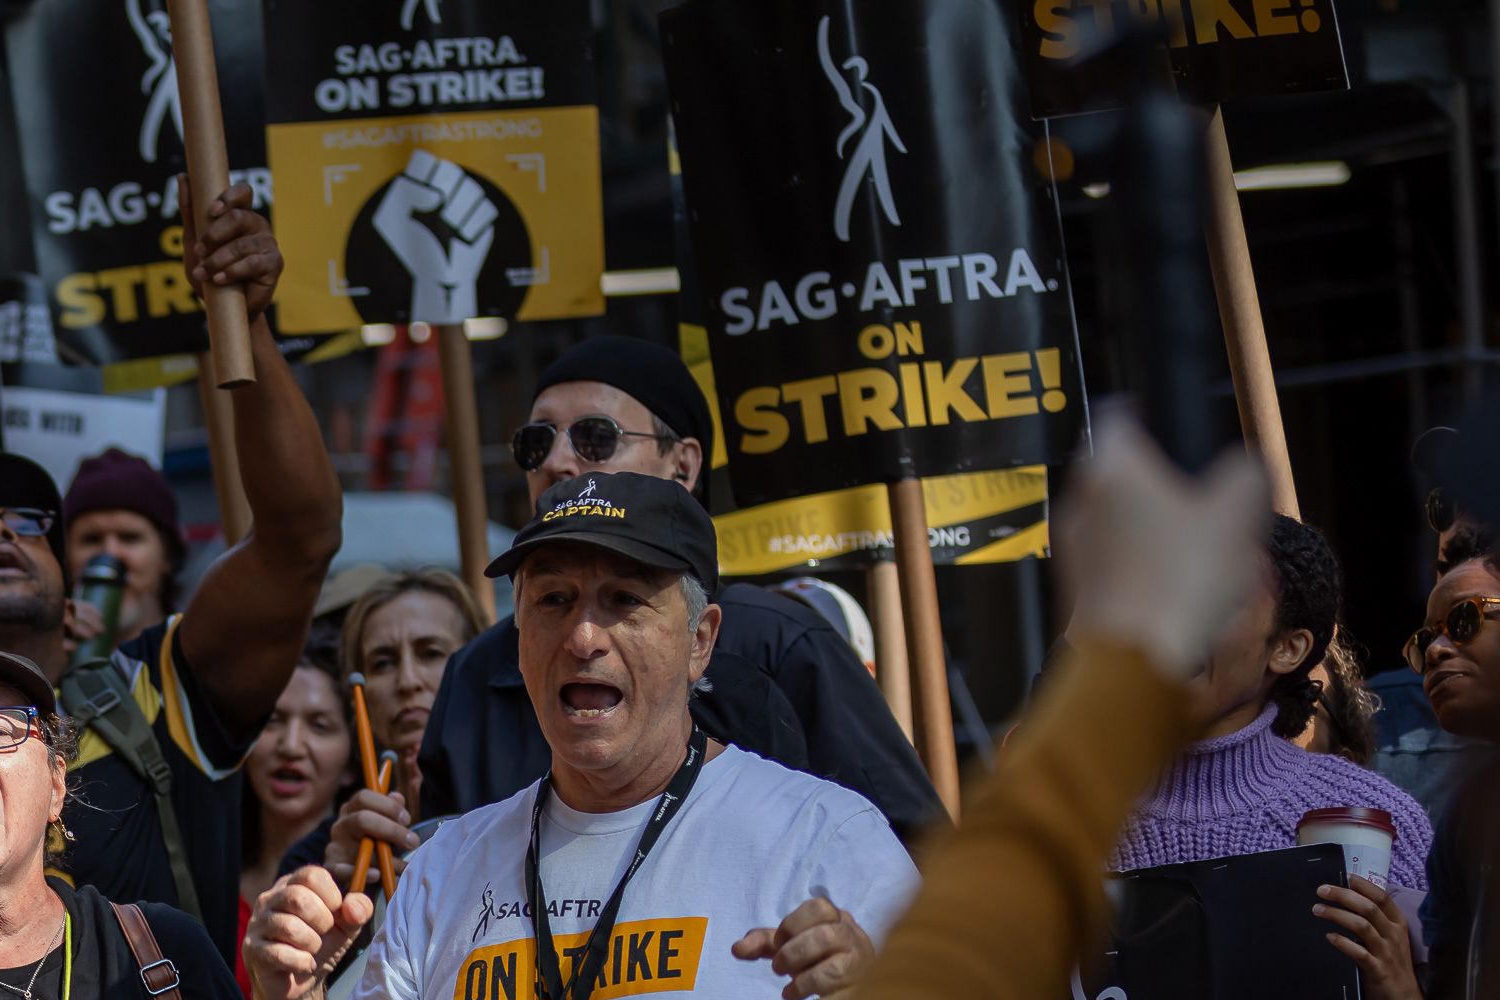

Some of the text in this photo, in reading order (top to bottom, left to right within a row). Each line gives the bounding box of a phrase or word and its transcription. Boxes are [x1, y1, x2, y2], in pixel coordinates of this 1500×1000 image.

[314, 66, 546, 113] ON STRIKE!
[857, 320, 926, 360] ON
[733, 347, 1069, 456] STRIKE!
[542, 505, 626, 522] CAPTAIN
